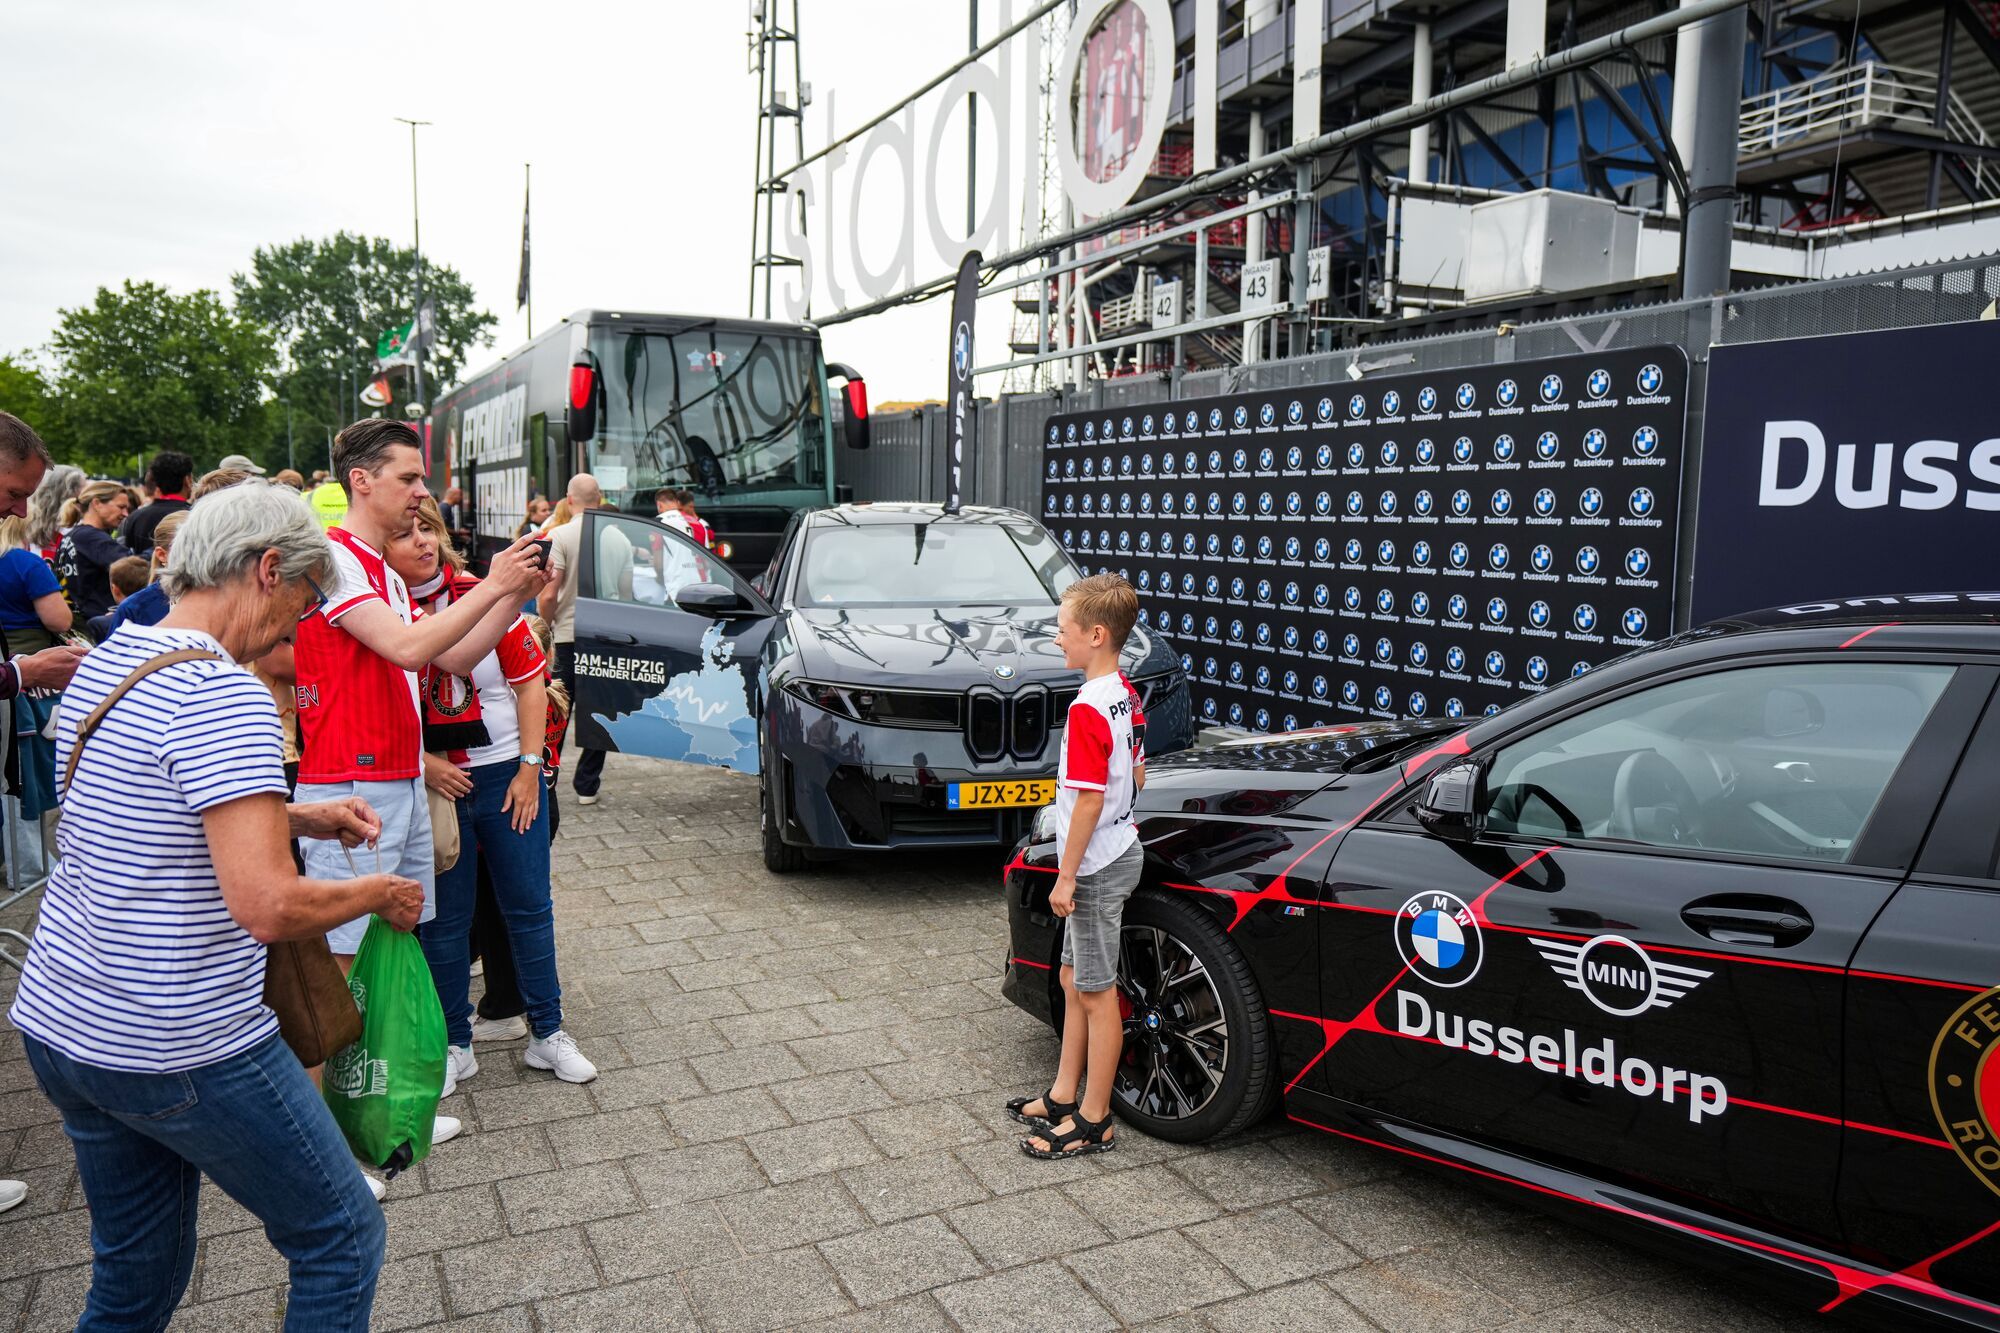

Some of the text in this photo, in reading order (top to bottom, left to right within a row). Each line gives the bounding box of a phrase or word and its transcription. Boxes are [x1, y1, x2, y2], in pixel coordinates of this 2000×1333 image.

[1246, 276, 1267, 299] 43
[1156, 297, 1172, 318] 42
[1578, 399, 1618, 408] Dusseldorp
[1627, 395, 1671, 404] Dusseldorp
[1489, 407, 1524, 415] Dusseldorp
[1532, 403, 1569, 412] Dusseldorp
[1412, 413, 1442, 421] Dusseldorp
[1449, 410, 1482, 418] Dusseldorp
[1376, 416, 1405, 424] Dusseldorp
[1486, 462, 1521, 470] Dusseldorp
[1528, 460, 1566, 468] Dusseldorp
[1574, 458, 1614, 467] Dusseldorp
[1623, 456, 1666, 466] Dusseldorp
[1374, 515, 1402, 523] Dusseldorp
[1408, 515, 1438, 524] Dusseldorp
[1445, 516, 1477, 524] Dusseldorp
[1484, 516, 1518, 525] Dusseldorp
[1526, 516, 1562, 525] Dusseldorp
[1571, 517, 1610, 526] Dusseldorp
[1619, 517, 1662, 527] Dusseldorp
[1372, 564, 1400, 573] Dusseldorp
[1407, 566, 1436, 575] Dusseldorp
[1443, 568, 1475, 577] Dusseldorp
[1482, 570, 1515, 580] Dusseldorp
[1523, 572, 1559, 582] Dusseldorp
[1568, 574, 1606, 585] Dusseldorp
[1616, 577, 1658, 588] Dusseldorp
[1371, 612, 1399, 622] Dusseldorp
[1405, 616, 1435, 626] Dusseldorp
[1441, 619, 1473, 630] Dusseldorp
[1480, 623, 1513, 634] Dusseldorp
[1521, 627, 1557, 638] Dusseldorp
[1565, 631, 1604, 643] Dusseldorp
[1370, 660, 1398, 671] Dusseldorp
[1404, 665, 1433, 676] Dusseldorp
[588, 666, 630, 680] ZONDER
[631, 671, 665, 684] LADEN
[1440, 670, 1471, 682] Dusseldorp
[1478, 676, 1512, 688] Dusseldorp
[1369, 708, 1397, 720] Dusseldorp
[1407, 896, 1471, 926] BMW
[1588, 961, 1645, 991] MINI
[1396, 990, 1728, 1124] Dusseldorp
